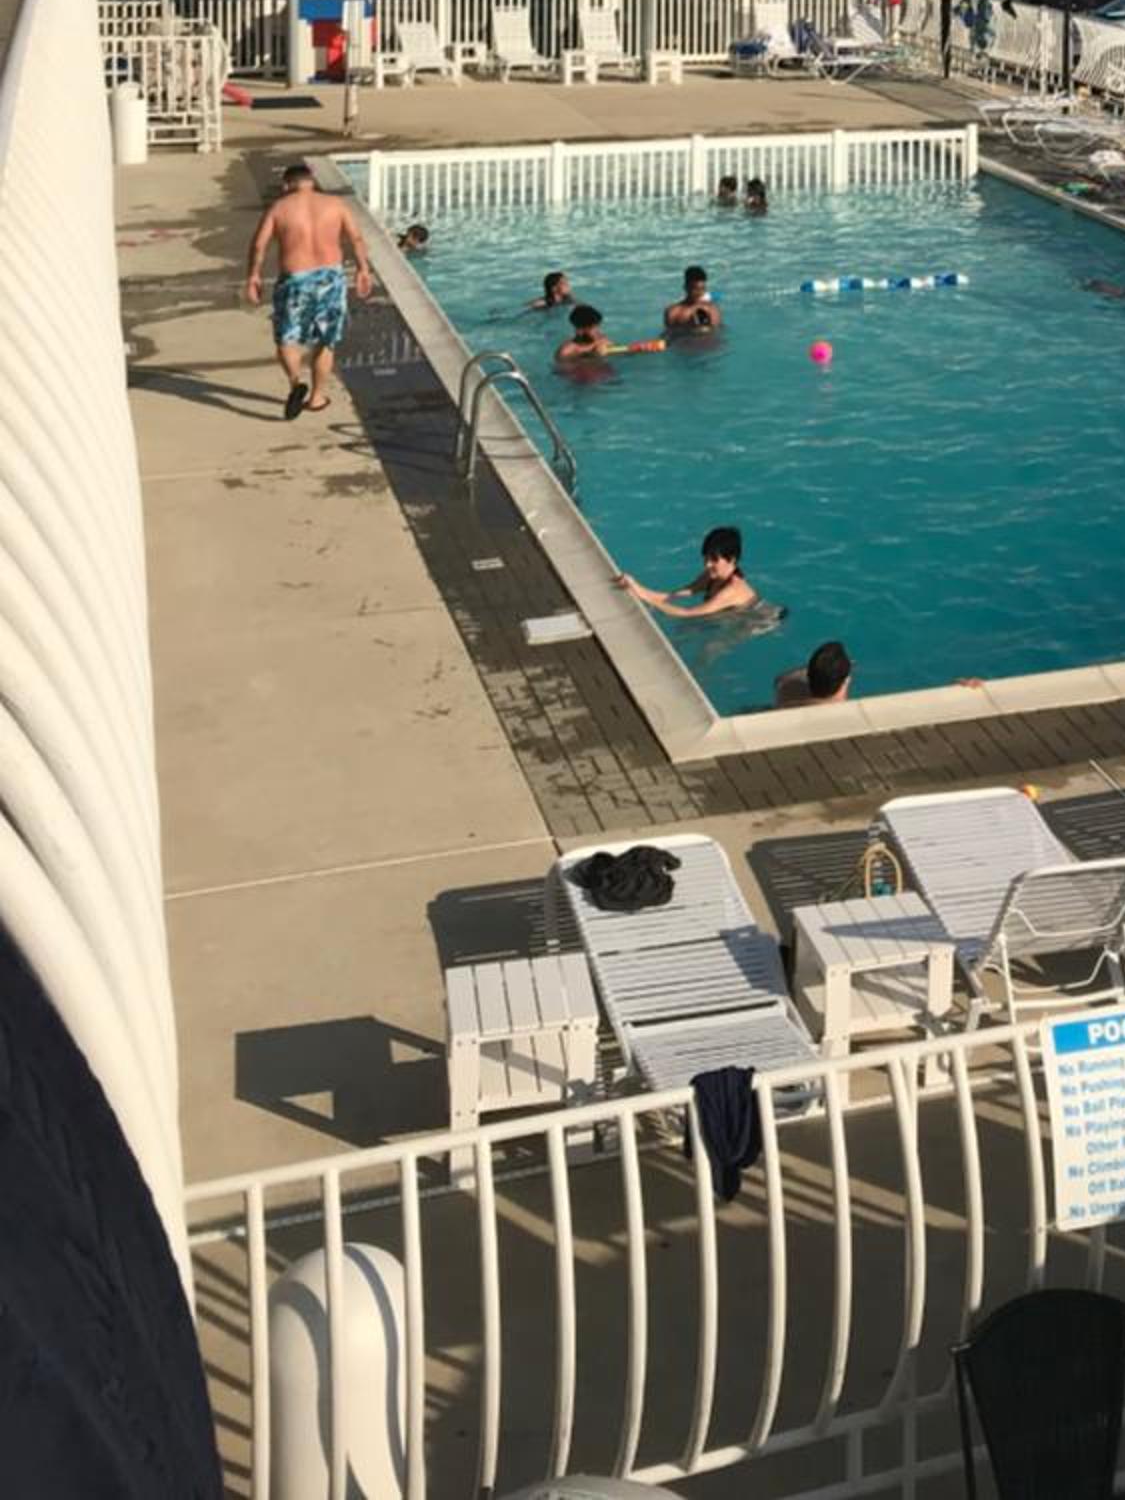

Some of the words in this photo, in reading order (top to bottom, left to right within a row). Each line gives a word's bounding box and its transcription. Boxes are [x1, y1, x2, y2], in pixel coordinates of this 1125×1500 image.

[1057, 1063, 1074, 1077] No
[1078, 1058, 1125, 1075] Running
[1061, 1084, 1078, 1097] No
[1064, 1104, 1080, 1118] No
[1082, 1100, 1106, 1115] Ball
[1065, 1123, 1082, 1138] No
[1087, 1141, 1119, 1156] Other
[1067, 1165, 1084, 1180] No
[1087, 1180, 1107, 1196] Off
[1070, 1204, 1086, 1220] No
